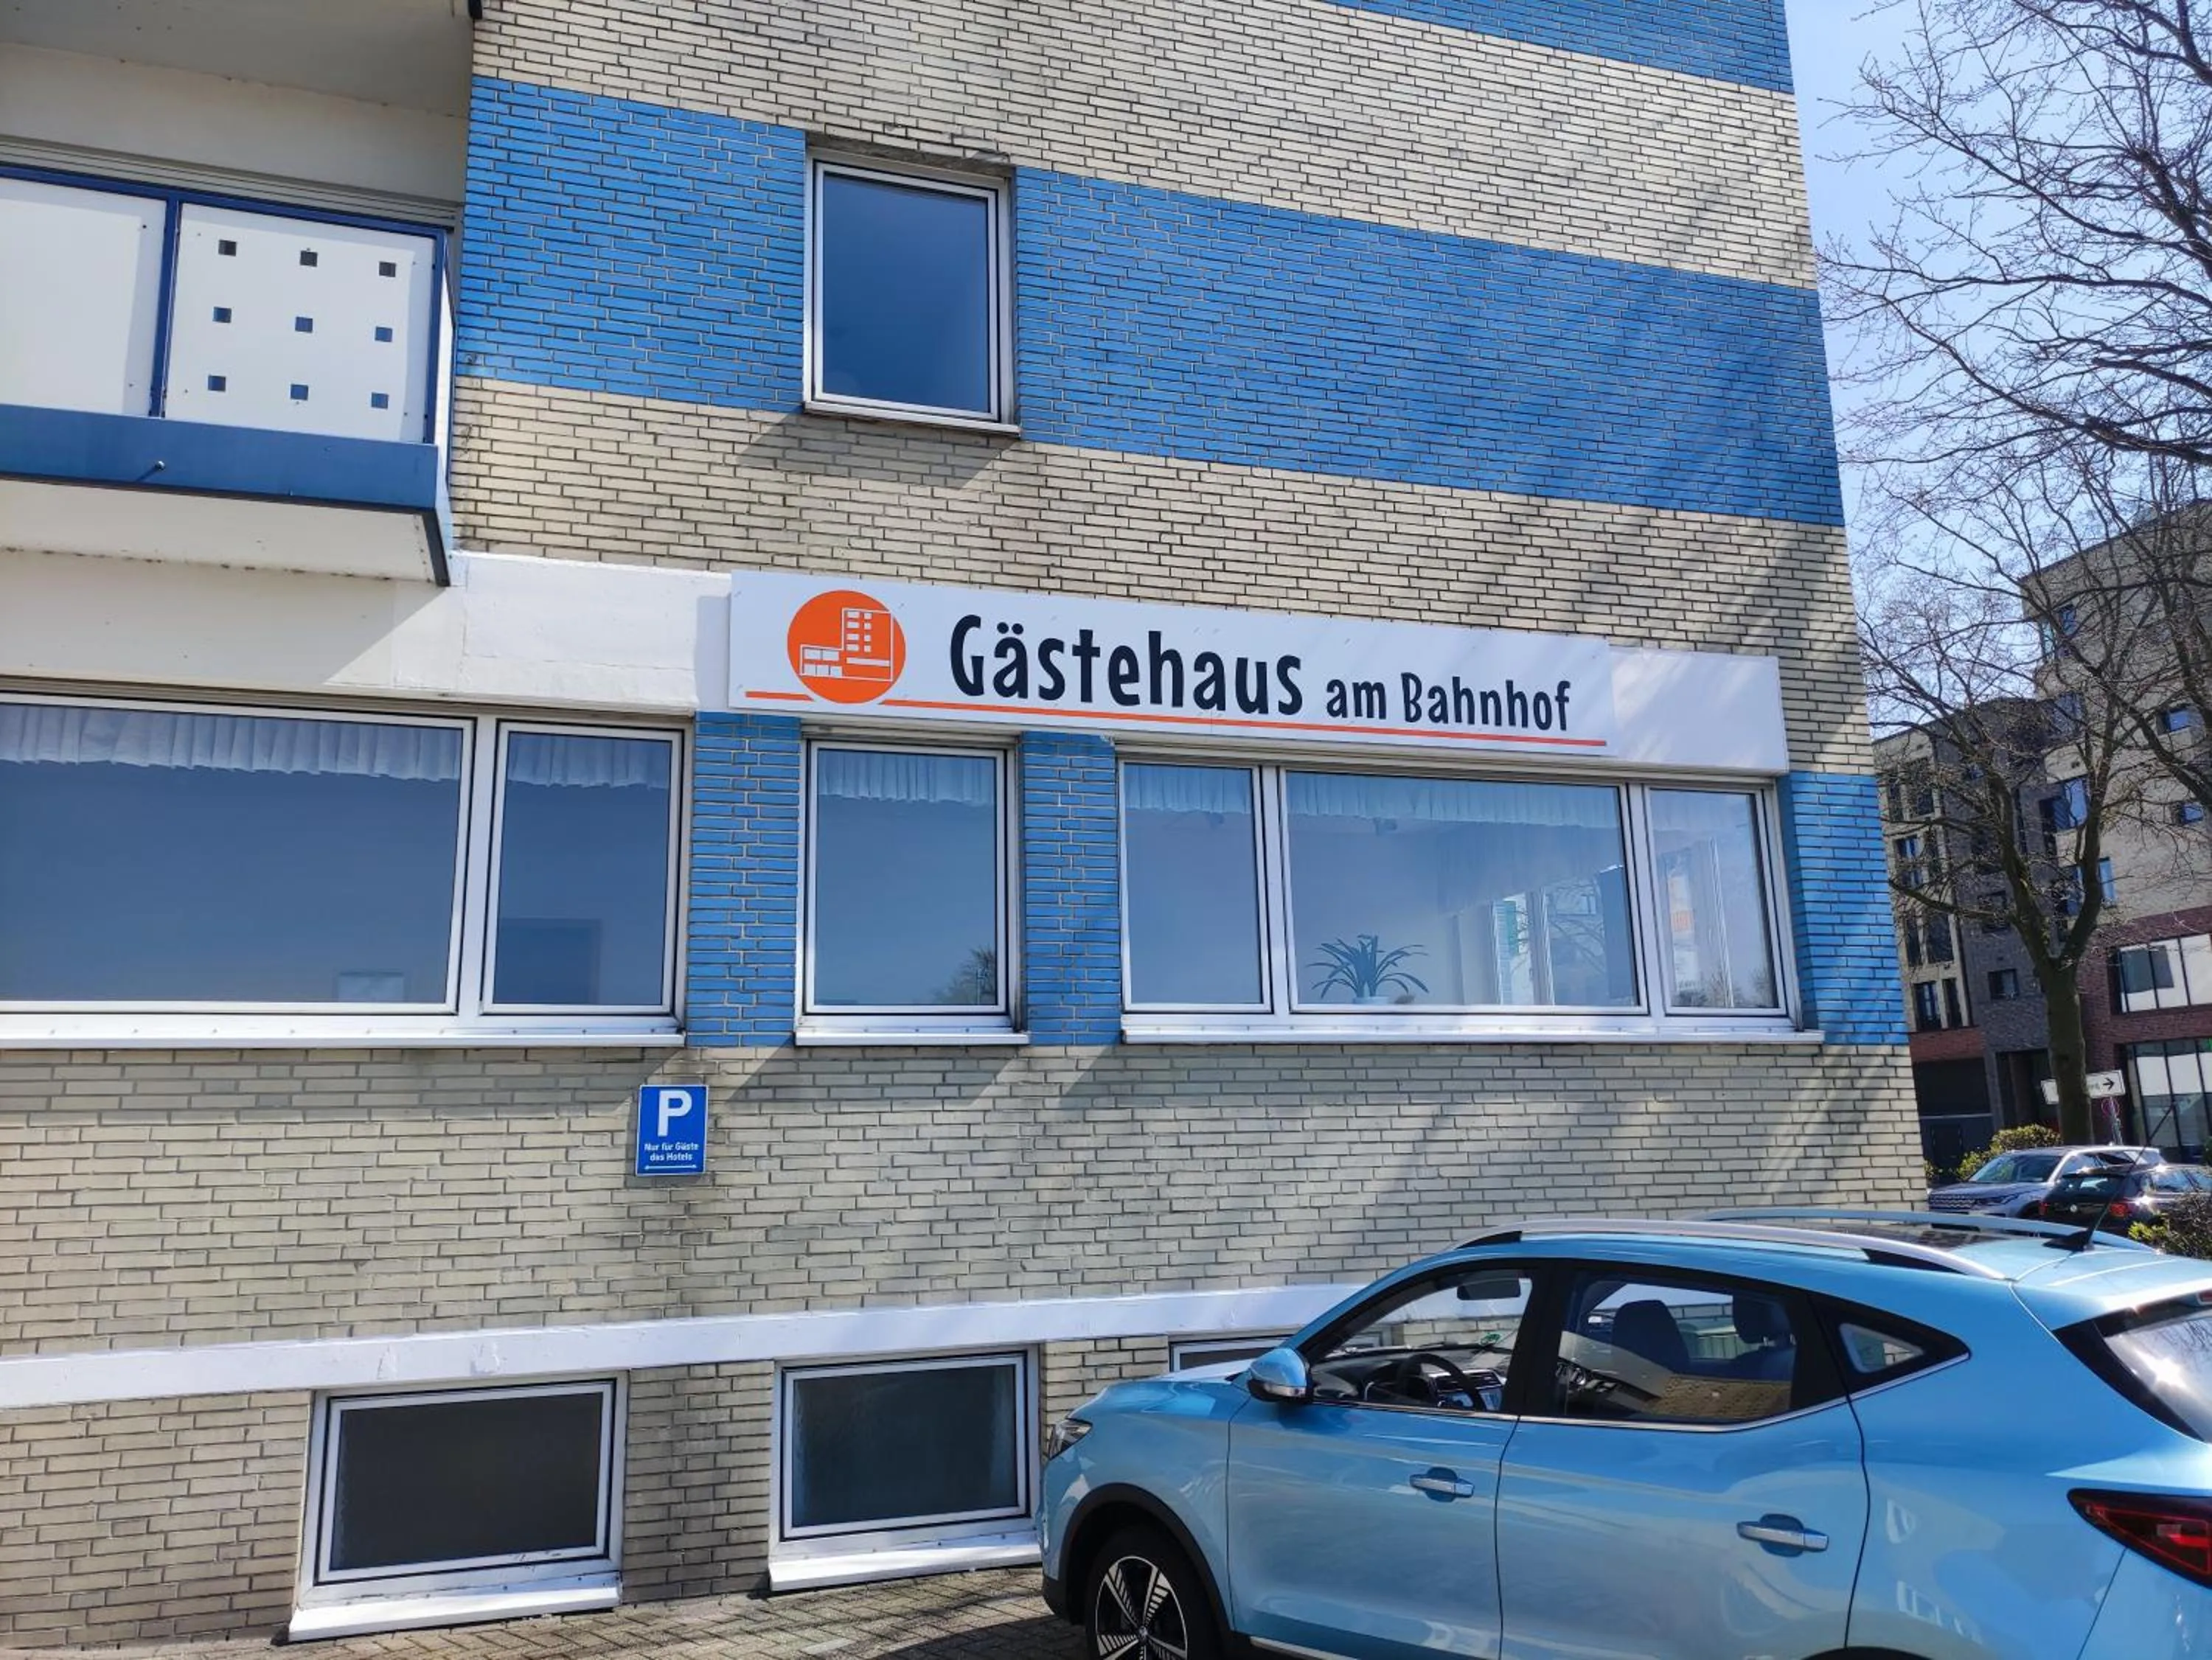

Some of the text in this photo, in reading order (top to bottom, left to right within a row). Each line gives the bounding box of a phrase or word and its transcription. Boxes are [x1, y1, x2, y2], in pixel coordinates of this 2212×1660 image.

[950, 614, 1571, 731] Gästehaus am Bahnhof
[658, 1090, 692, 1137] P
[644, 1143, 659, 1151] Nur
[667, 1152, 693, 1161] Hotels
